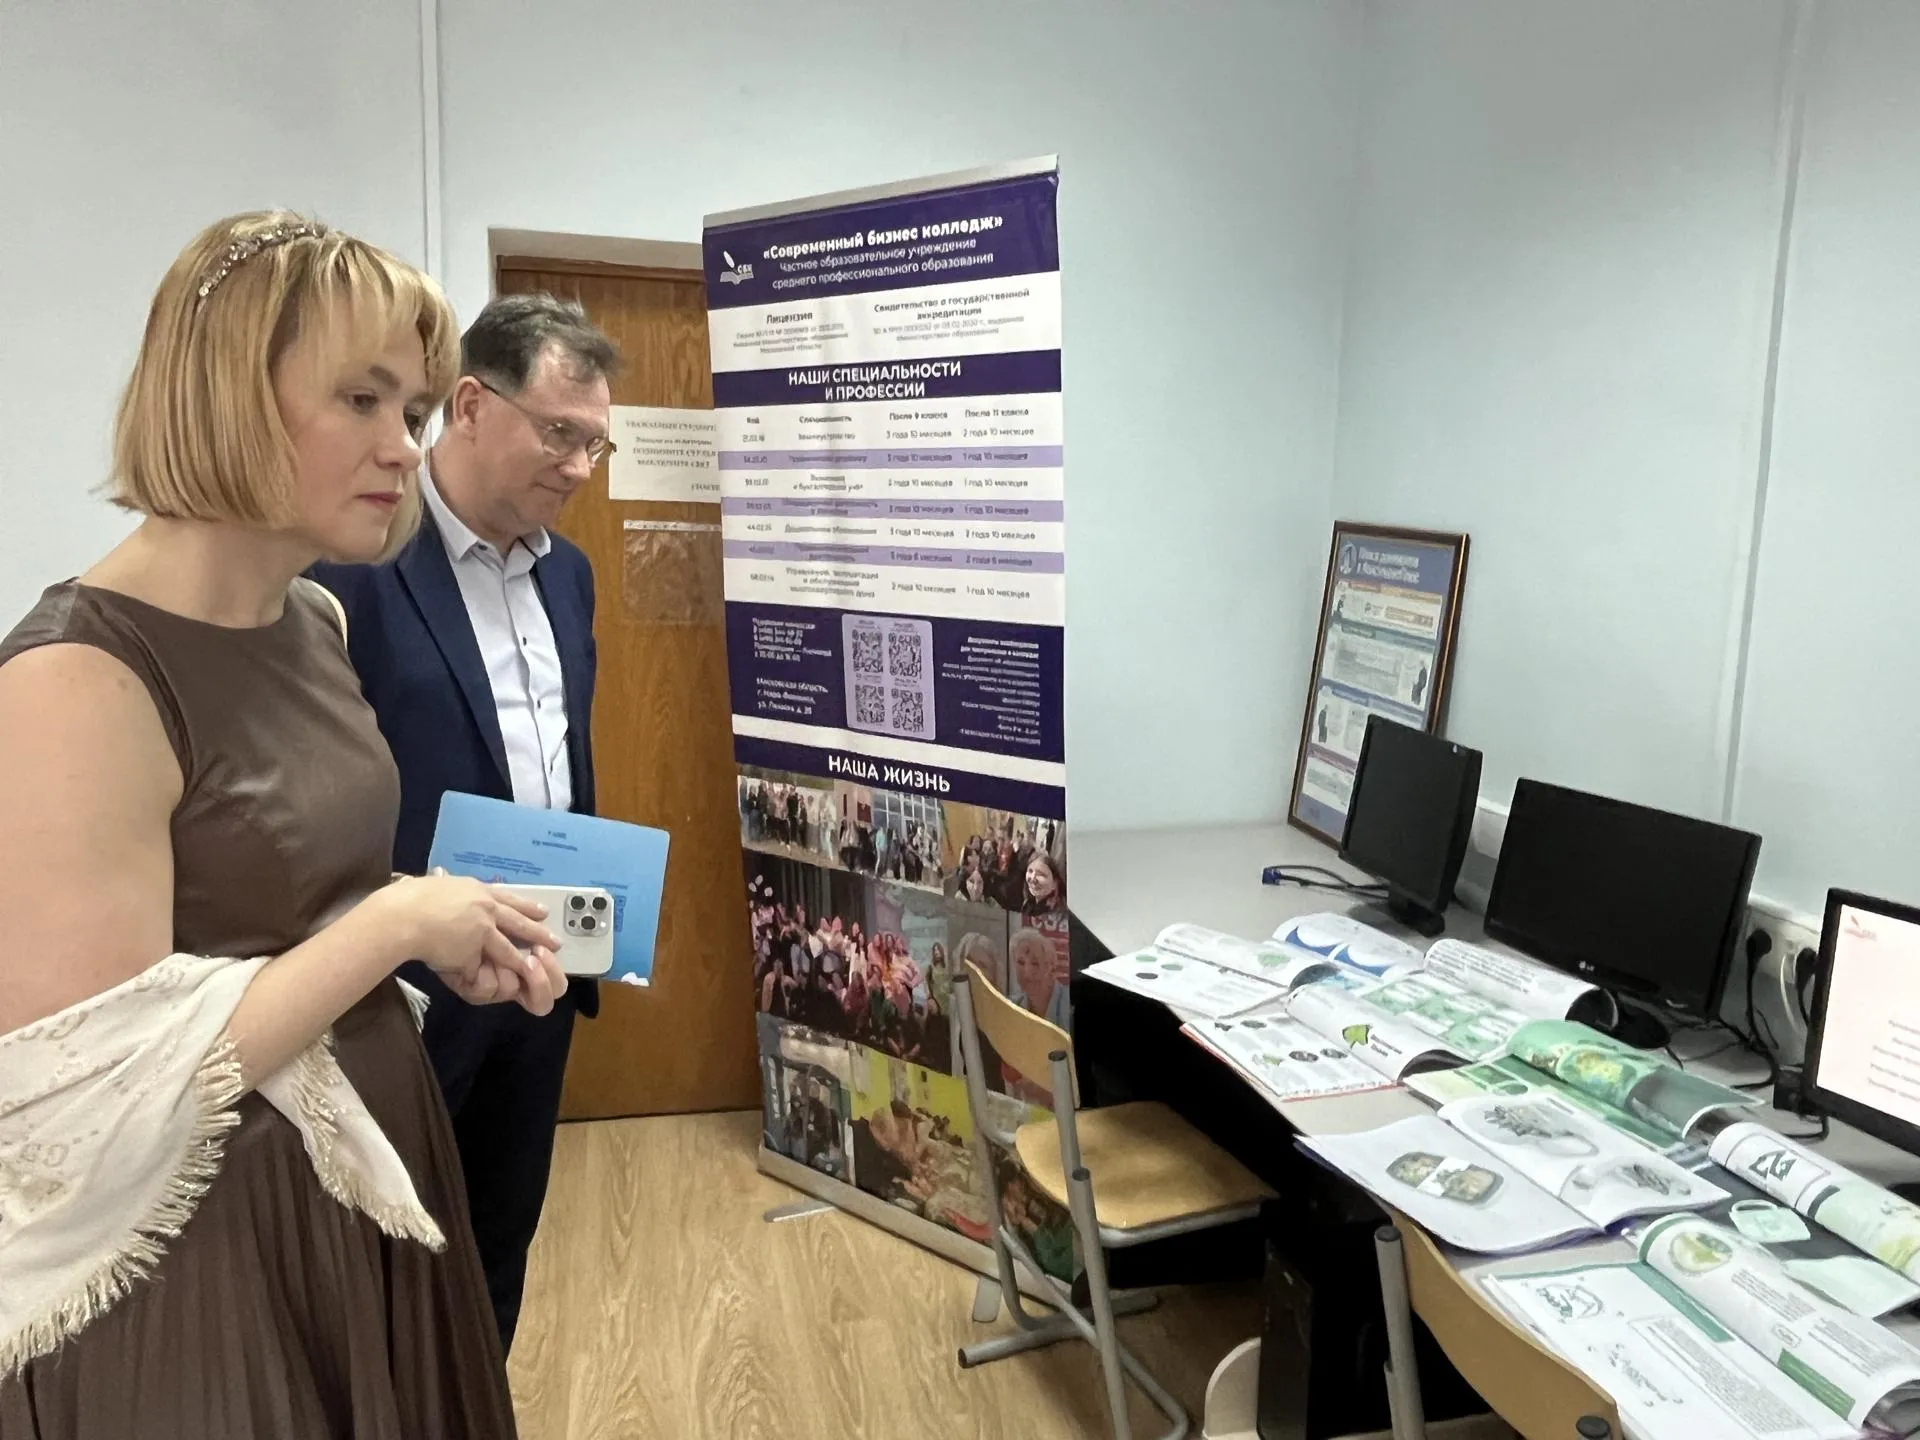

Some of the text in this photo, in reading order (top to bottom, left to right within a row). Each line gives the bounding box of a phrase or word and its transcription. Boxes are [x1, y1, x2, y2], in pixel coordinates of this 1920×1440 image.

[763, 216, 1003, 259] «Современный бизнес колледж»
[820, 248, 906, 268] образовательное
[908, 238, 977, 259] учреждение
[772, 252, 994, 290] среднего профессионального образования
[766, 312, 813, 324] Лицензия
[788, 361, 961, 387] НАШИ СПЕЦИАЛЬНОСТИ
[825, 382, 925, 401] И ПРОФЕССИИ
[828, 755, 950, 792] НАША ЖИЗНЬ
